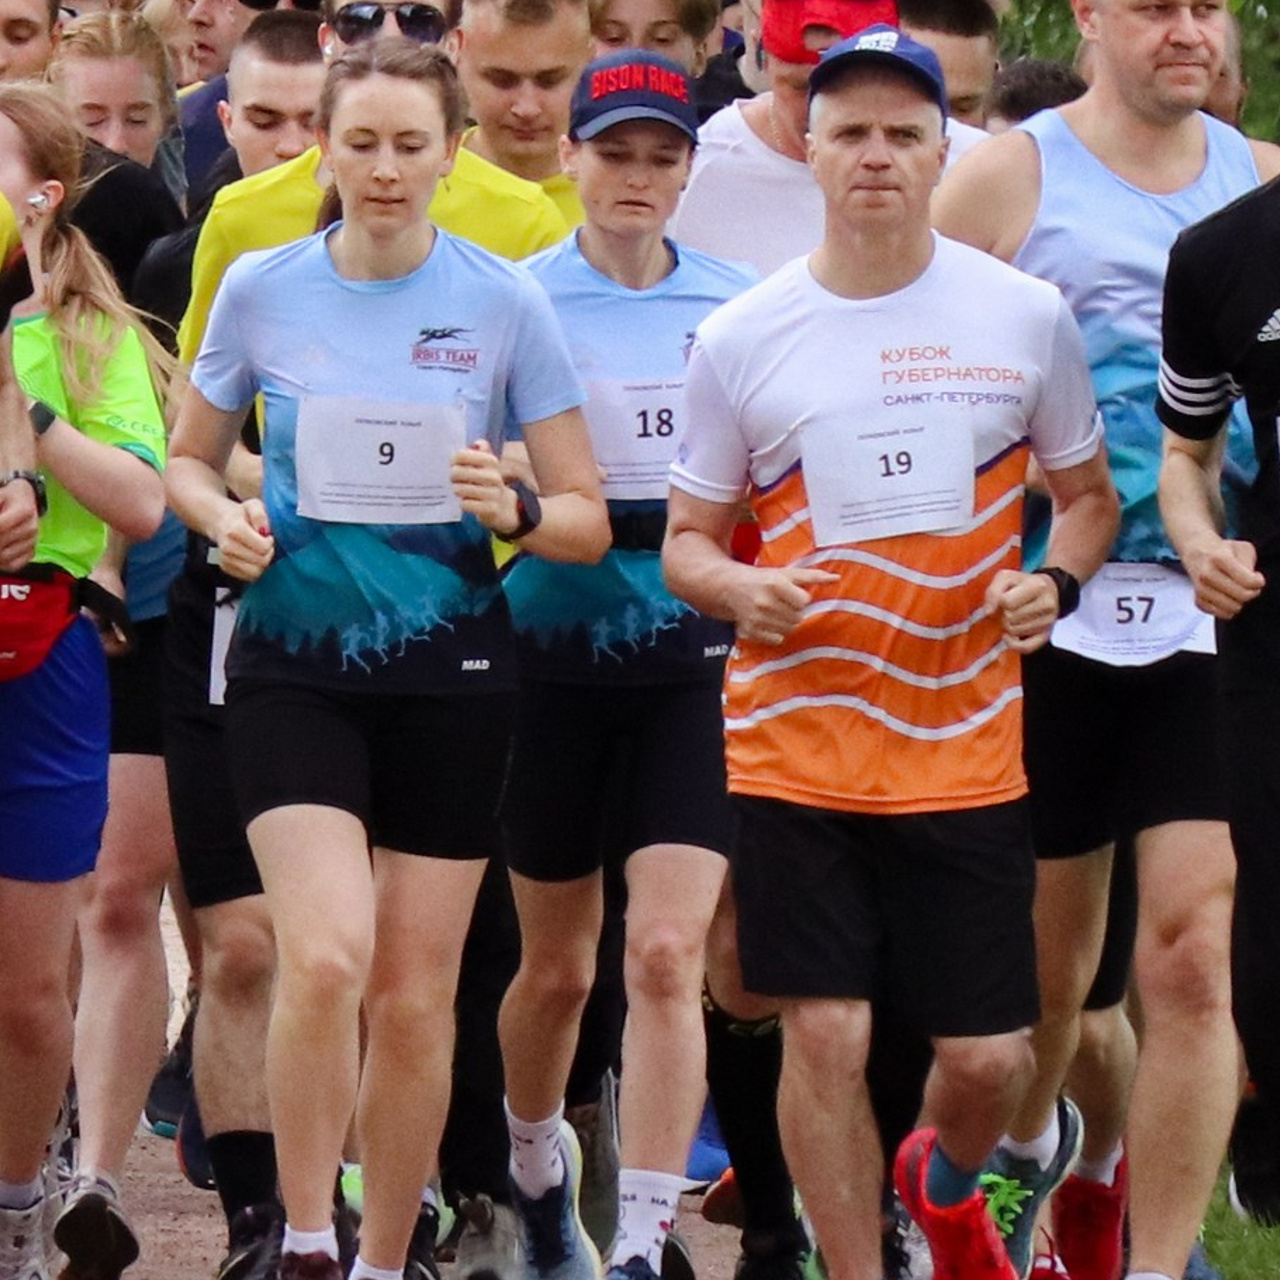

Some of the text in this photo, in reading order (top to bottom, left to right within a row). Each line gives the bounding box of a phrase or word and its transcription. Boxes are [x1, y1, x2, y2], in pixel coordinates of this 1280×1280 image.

[591, 64, 690, 105] BISON RACE
[446, 350, 478, 367] TEAM
[880, 346, 952, 364] КУБОК
[882, 367, 1025, 385] ГУБЕРНАТОРА
[882, 391, 1024, 407] САНКТ-ПЕТЕРБУРГА
[637, 407, 675, 439] 18
[378, 441, 395, 466] 9
[878, 450, 913, 478] 19
[1115, 595, 1156, 625] 57
[703, 643, 730, 659] MAD
[460, 658, 491, 672] MAD
